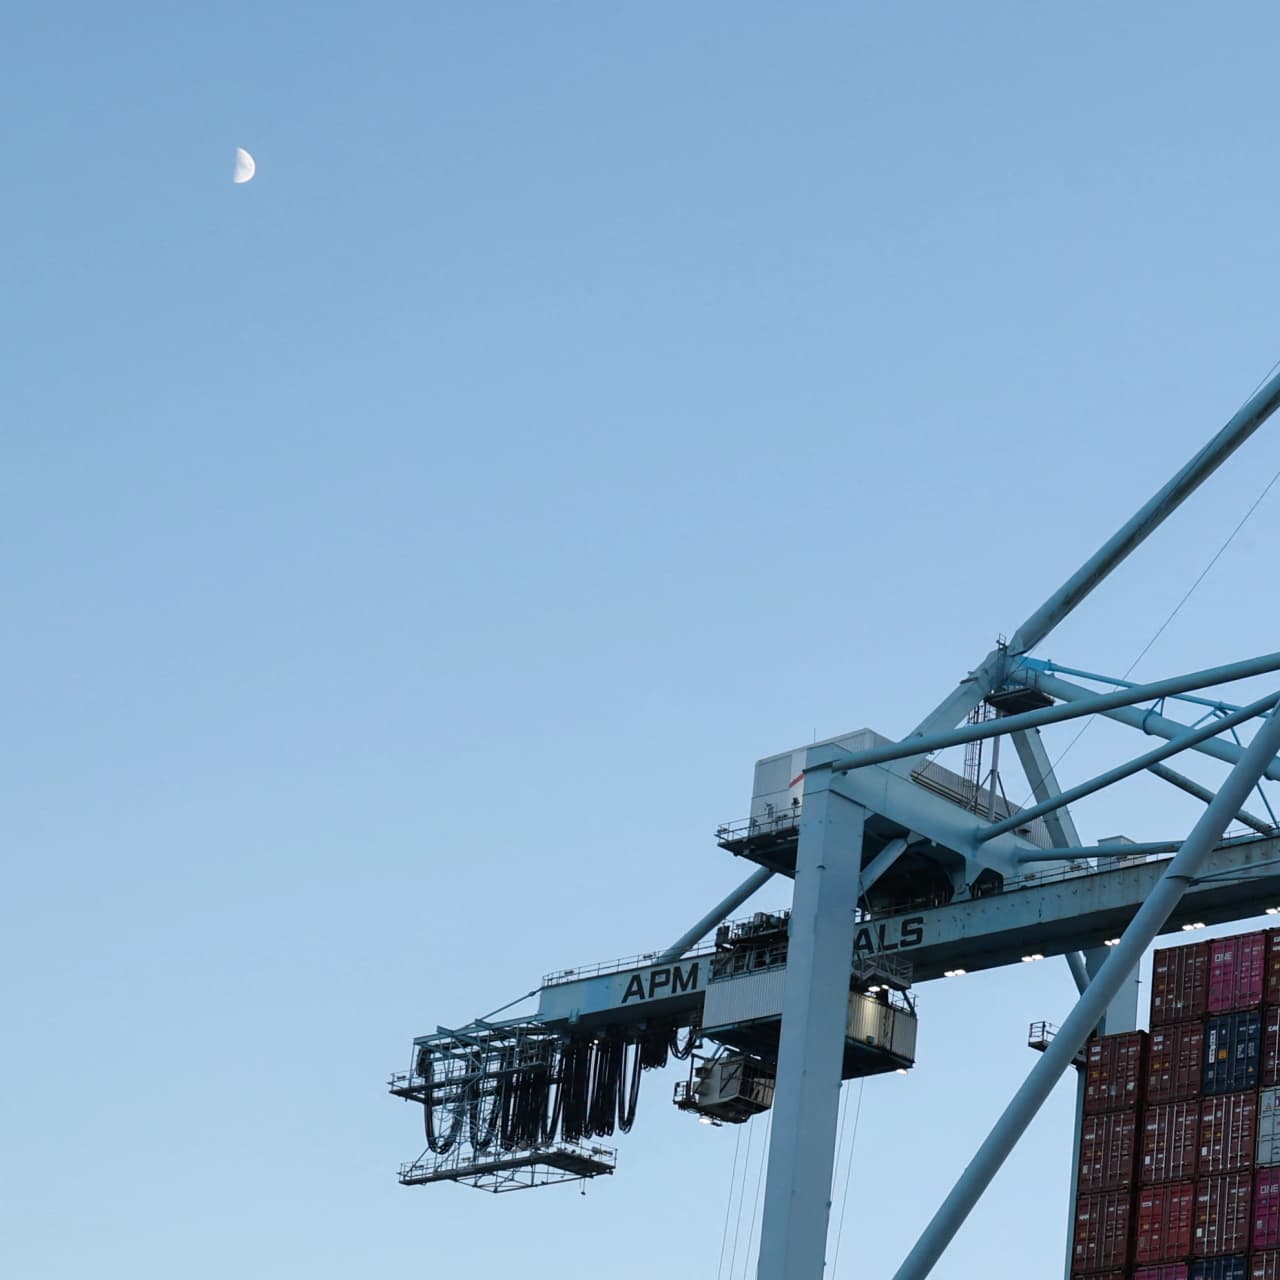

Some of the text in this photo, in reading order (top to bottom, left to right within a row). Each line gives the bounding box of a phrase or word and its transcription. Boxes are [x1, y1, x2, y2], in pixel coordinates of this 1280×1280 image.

[1215, 951, 1232, 962] ONE
[621, 963, 700, 1003] APM
[1260, 1184, 1279, 1194] ONE
